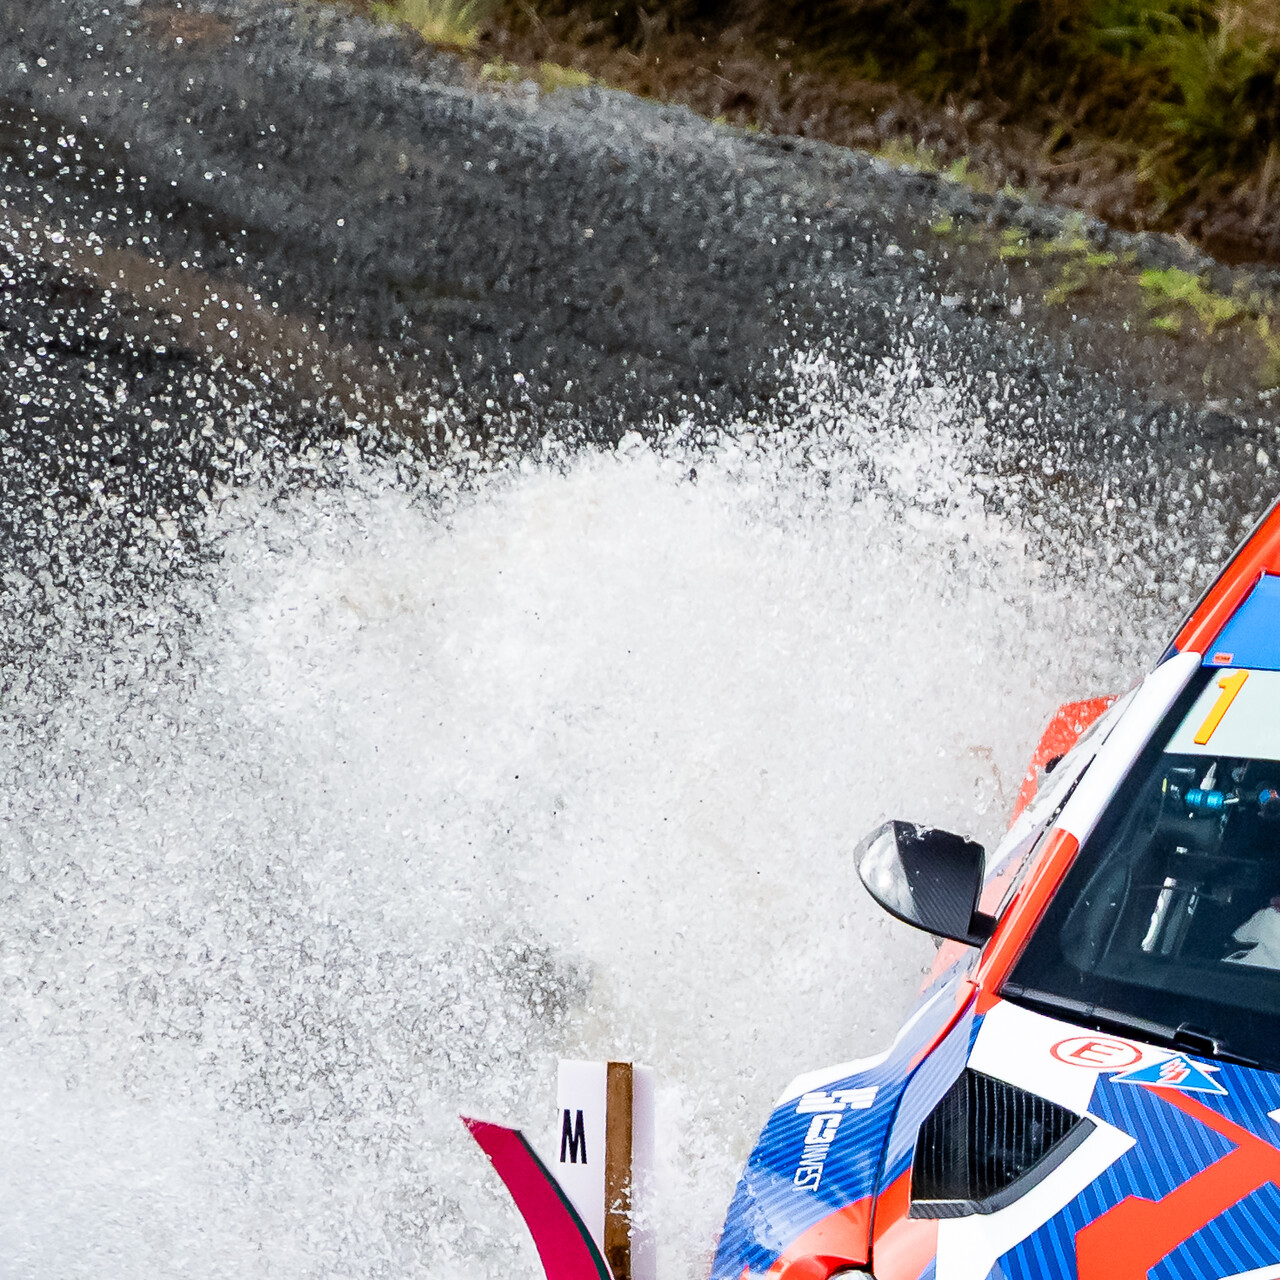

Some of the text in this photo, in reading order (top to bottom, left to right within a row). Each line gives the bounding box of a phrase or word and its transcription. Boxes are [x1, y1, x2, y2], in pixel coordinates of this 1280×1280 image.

[1193, 669, 1249, 745] 1
[559, 1108, 588, 1164] M
[791, 1143, 830, 1192] INVEST
